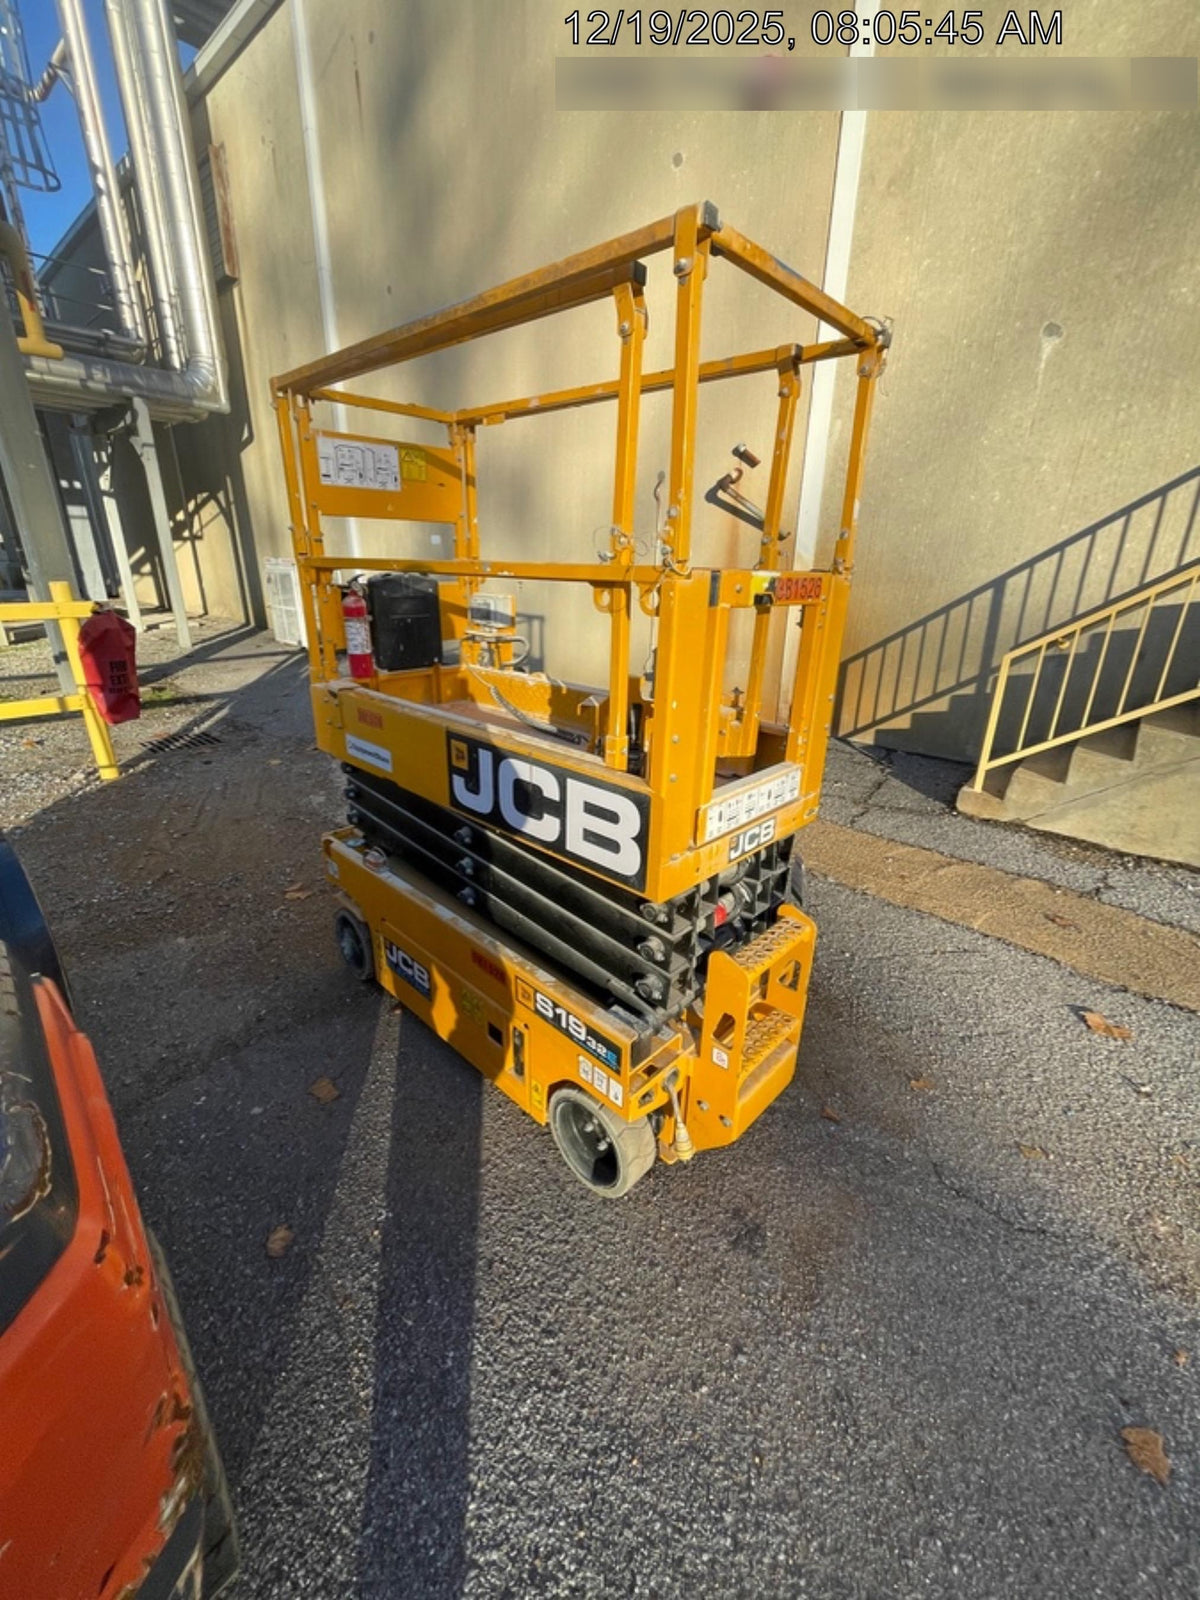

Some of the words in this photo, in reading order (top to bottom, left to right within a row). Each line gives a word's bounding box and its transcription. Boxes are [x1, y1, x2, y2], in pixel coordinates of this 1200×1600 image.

[452, 748, 641, 876] JCB
[730, 818, 776, 860] JCB
[386, 943, 430, 989] JCB
